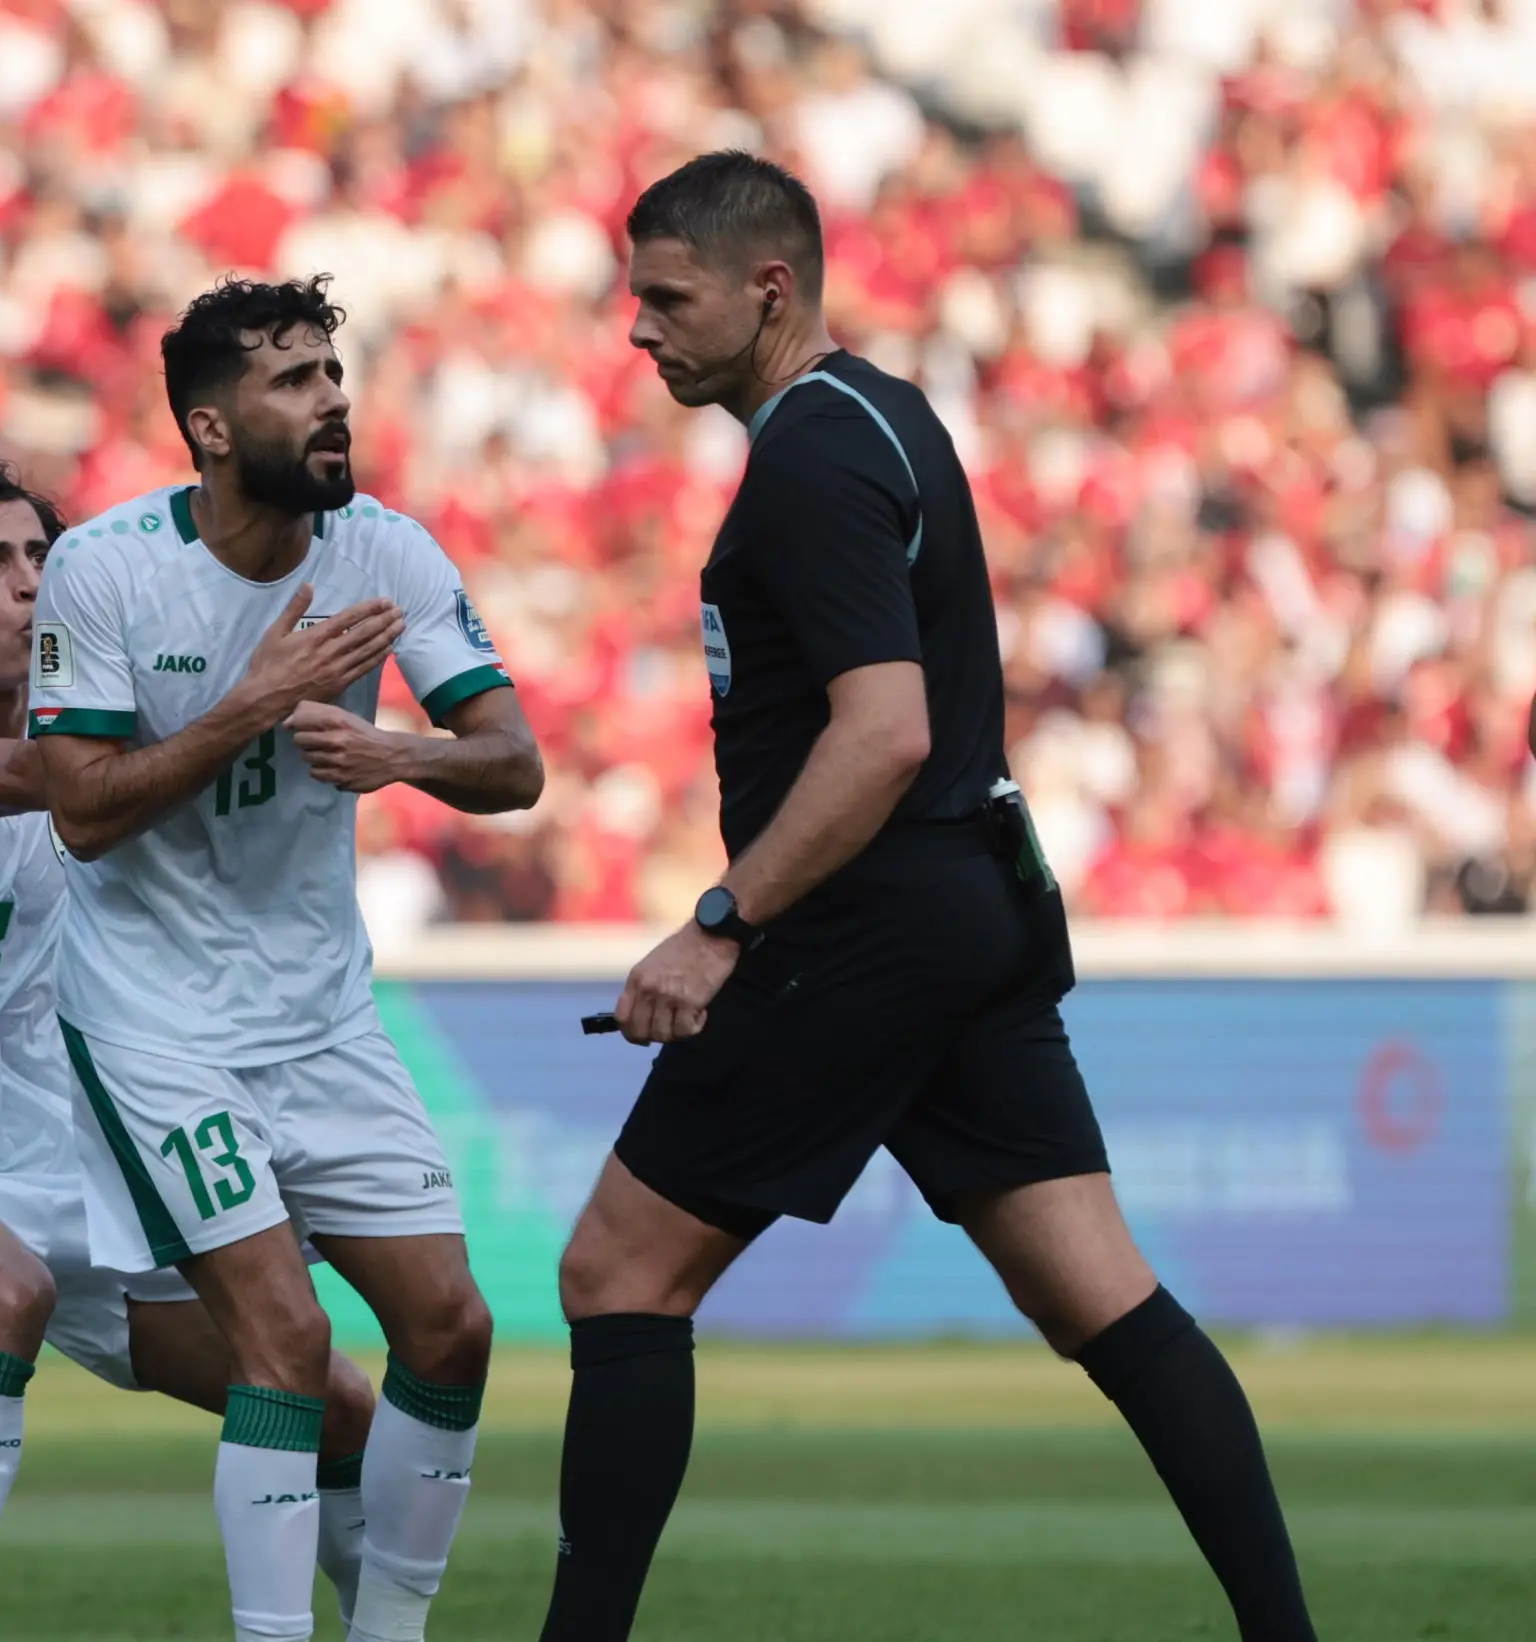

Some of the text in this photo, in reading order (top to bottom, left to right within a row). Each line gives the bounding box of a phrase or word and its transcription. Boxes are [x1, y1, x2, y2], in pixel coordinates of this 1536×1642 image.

[152, 654, 207, 674] JAKO
[215, 727, 277, 818] 13
[160, 1111, 257, 1221] 13
